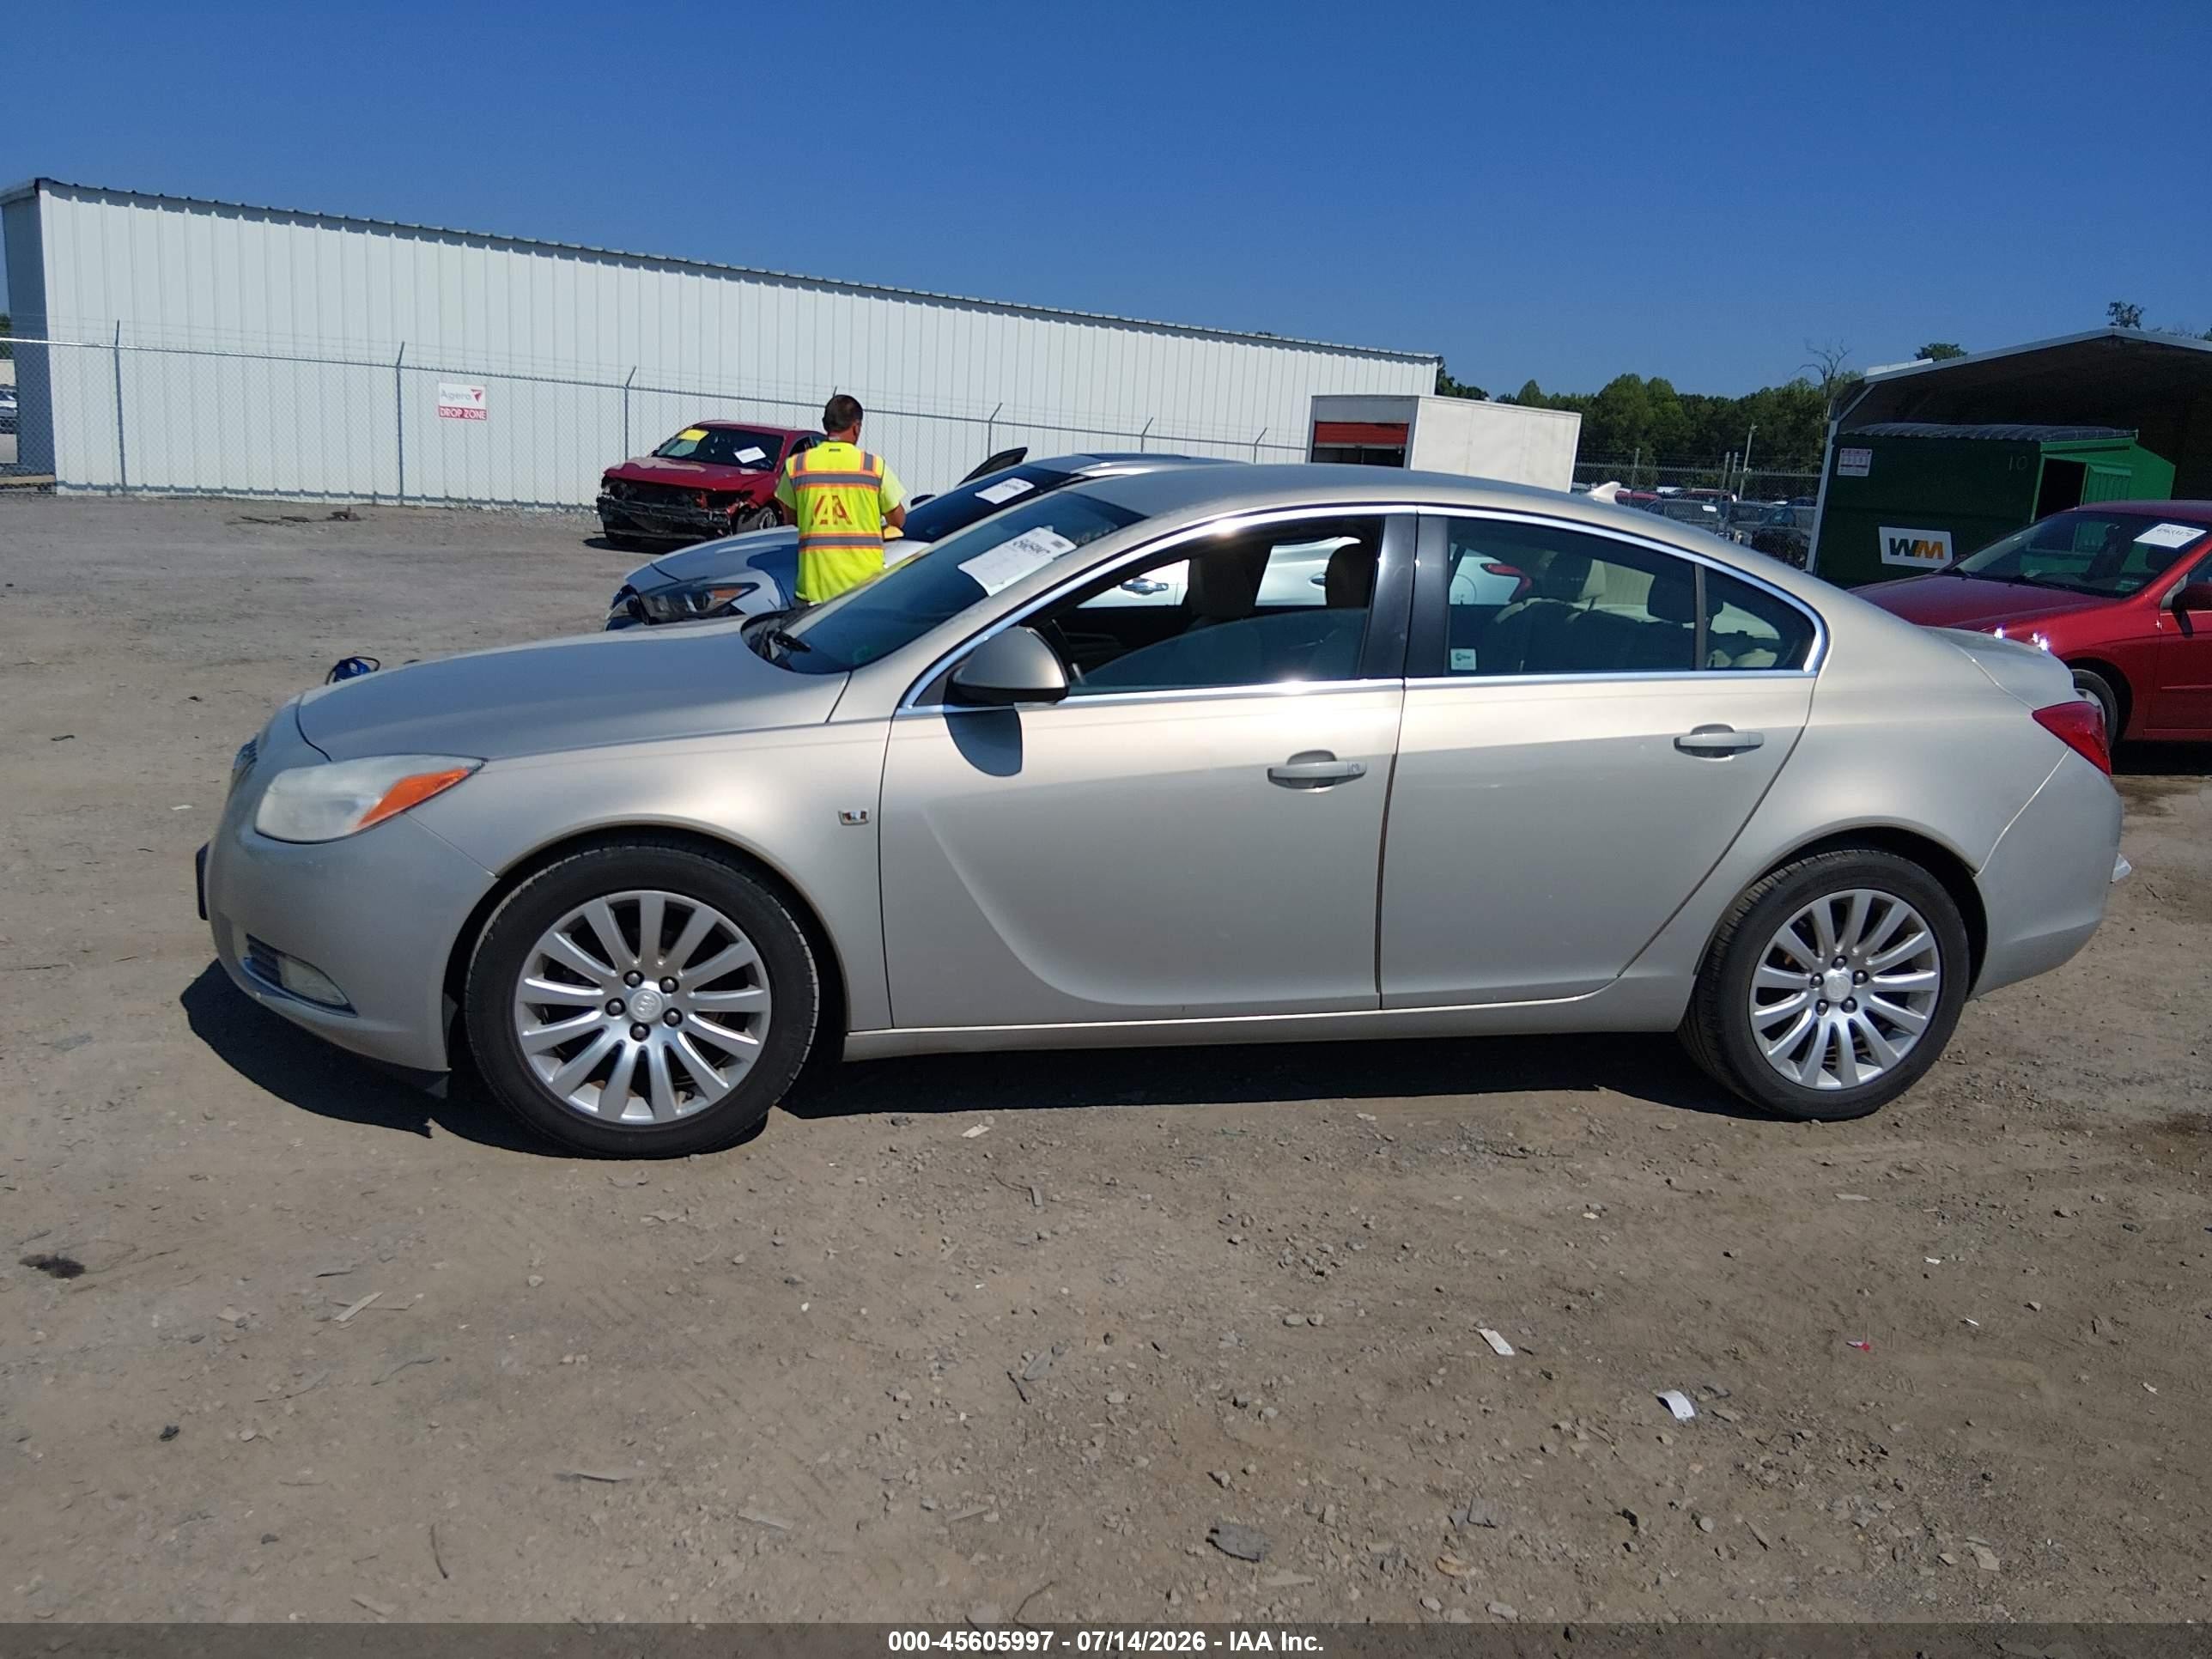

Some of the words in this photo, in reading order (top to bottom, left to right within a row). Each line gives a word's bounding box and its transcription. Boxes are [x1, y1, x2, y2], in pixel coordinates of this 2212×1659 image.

[440, 408, 462, 417] DROP
[465, 409, 486, 419] ZONE
[1889, 538, 1945, 560] WM
